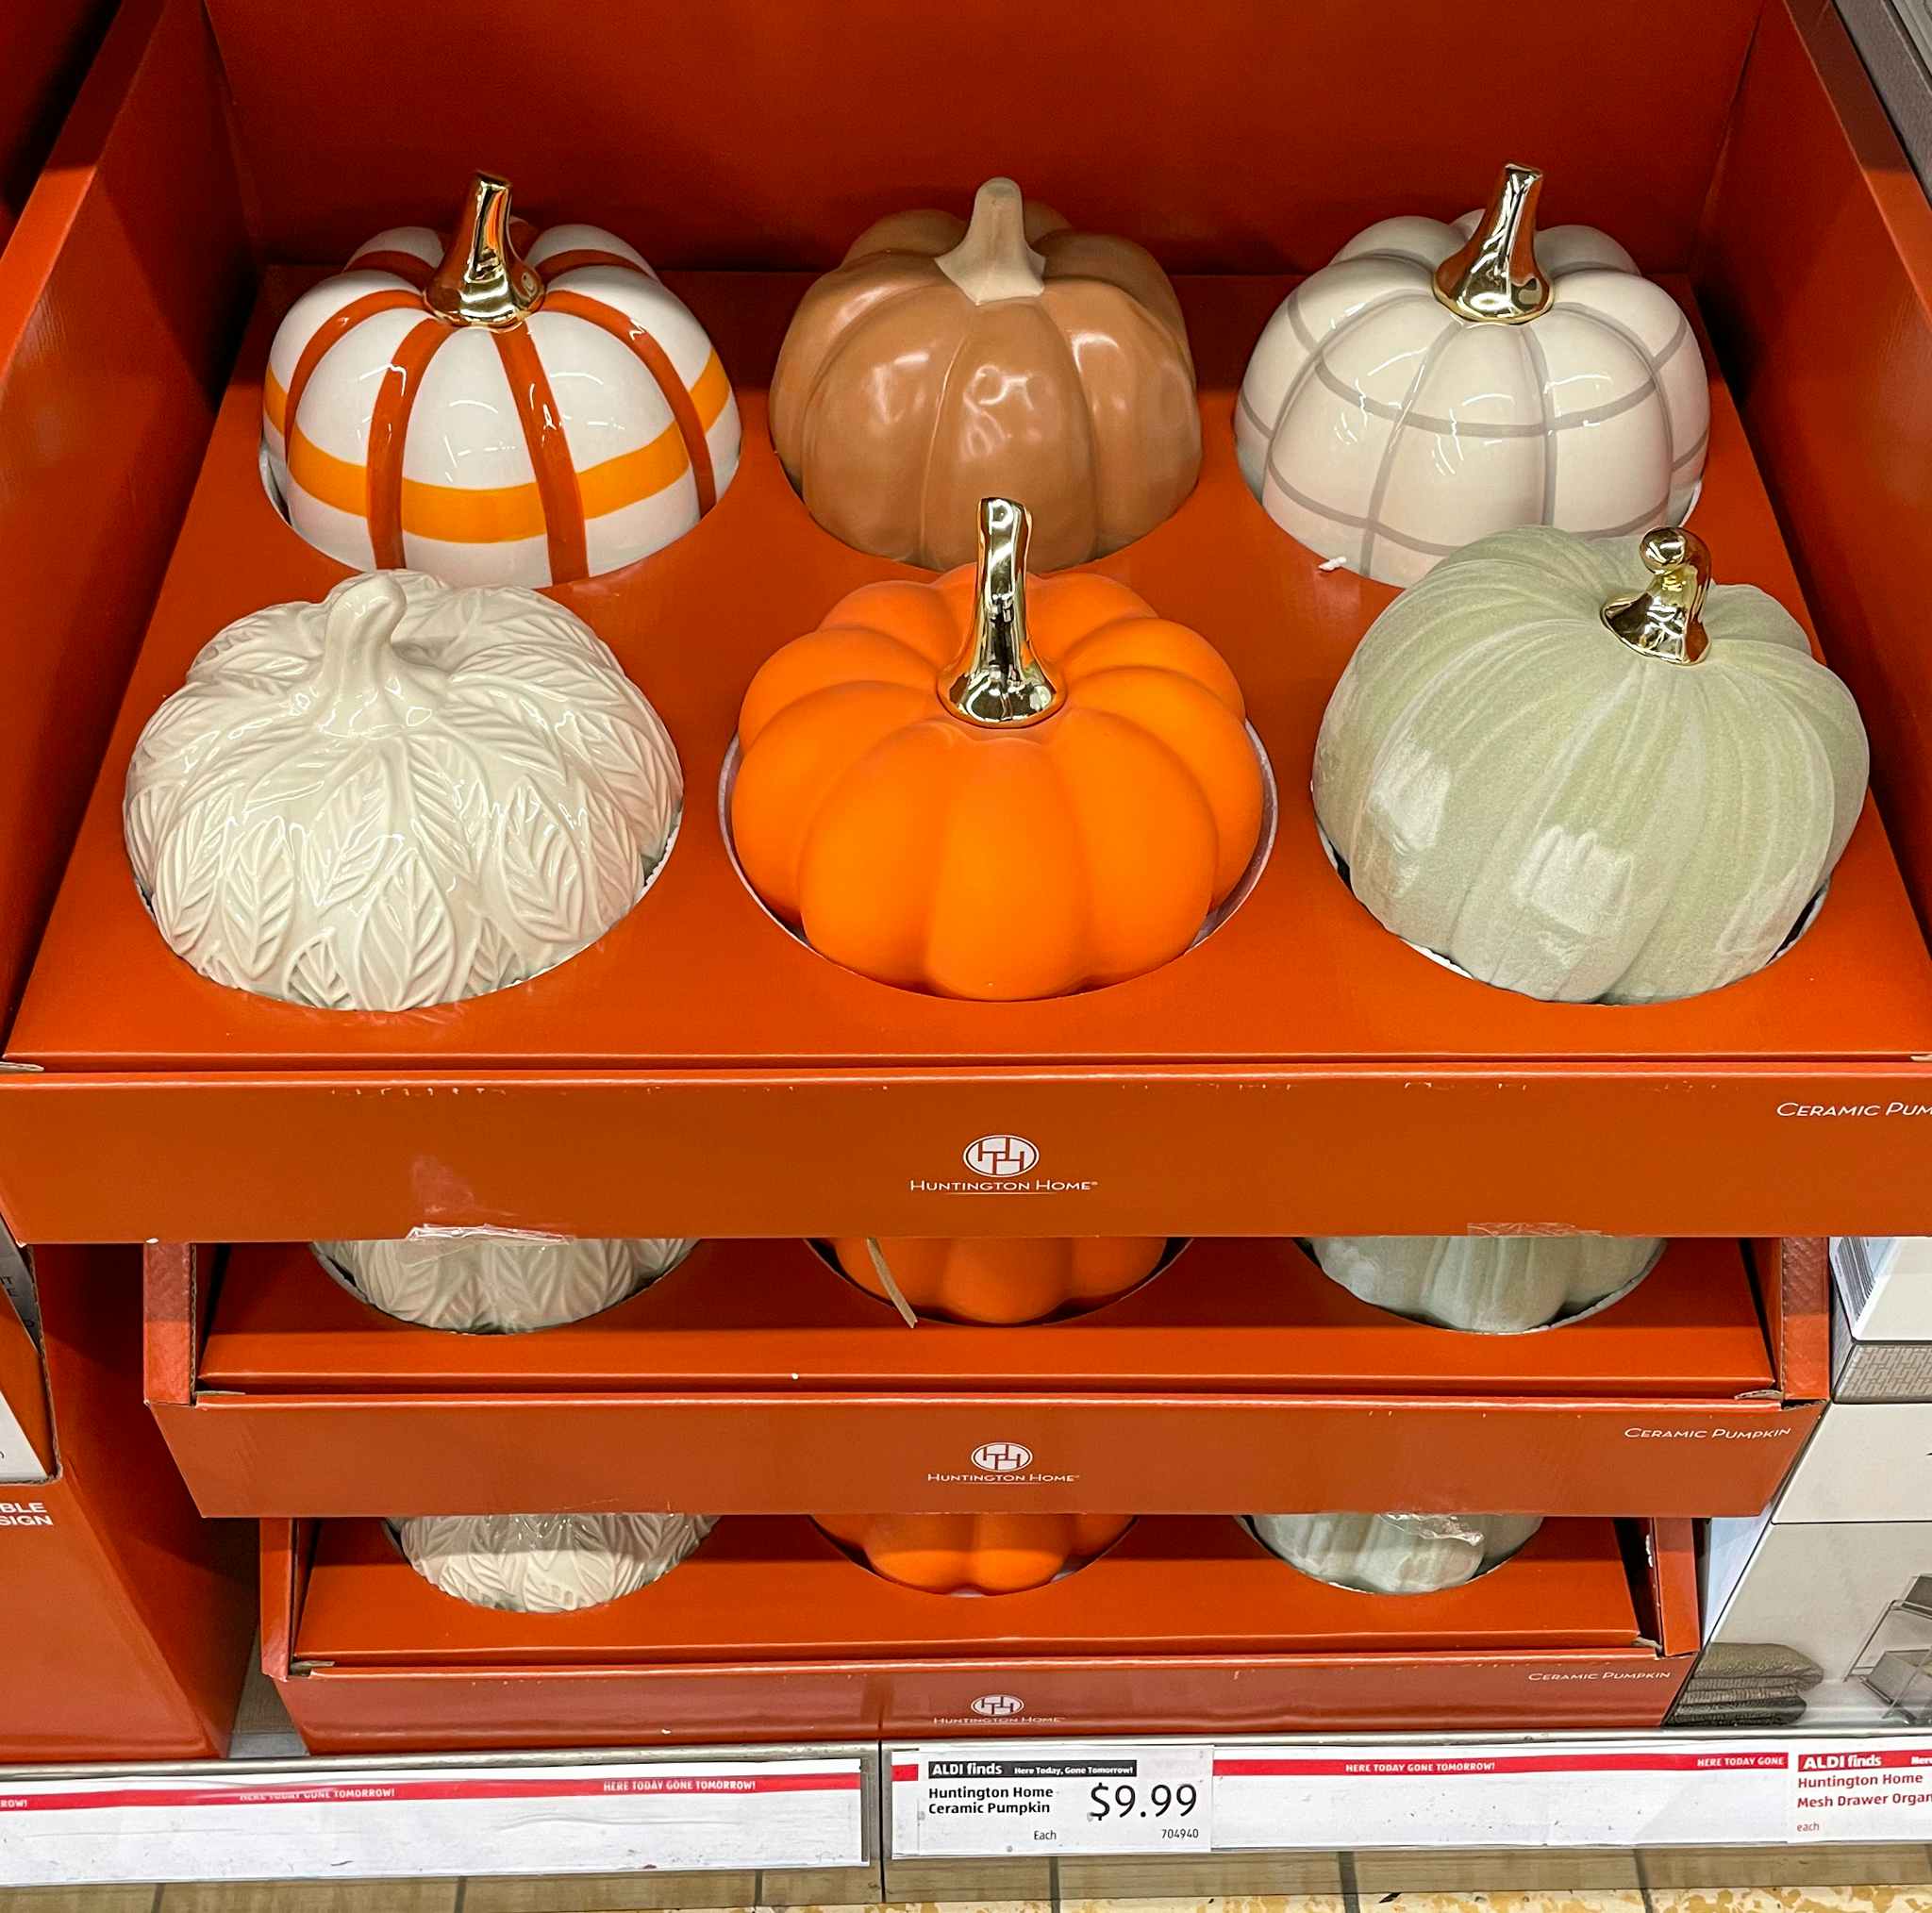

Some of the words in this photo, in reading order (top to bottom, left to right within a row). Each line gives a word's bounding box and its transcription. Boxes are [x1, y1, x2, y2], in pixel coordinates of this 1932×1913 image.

[1776, 1102, 1881, 1117] CERAMIC
[910, 1180, 1030, 1192] HUNTINGTON
[1624, 1427, 1707, 1439] CERAMIC
[1711, 1427, 1791, 1439] PUMPKIN
[927, 1473, 1025, 1483] HUNTINGTON
[1528, 1672, 1598, 1681] CERAMIC
[1602, 1672, 1671, 1680] PUMPKIN
[1345, 1764, 1371, 1772] HERE
[1407, 1763, 1433, 1772] GONE
[1436, 1762, 1494, 1772] TOMORROW!
[1697, 1757, 1722, 1767] HERE
[1724, 1757, 1756, 1766] TODAY
[1757, 1756, 1784, 1765] GONE
[1804, 1755, 1844, 1770] ALDI
[1847, 1755, 1881, 1768] finds
[932, 1763, 963, 1775] ALDI
[967, 1762, 1003, 1775] finds
[1036, 1767, 1063, 1776] Today,
[1087, 1766, 1133, 1774] Tomorrow!
[603, 1781, 629, 1791] HERE
[632, 1781, 663, 1791] TODAY
[666, 1780, 693, 1790] GONE
[695, 1780, 756, 1789] TOMORROW!
[1798, 1775, 1878, 1789] Huntington
[1882, 1773, 1924, 1785] Home
[333, 1788, 395, 1798] TOMORROW!
[928, 1787, 1009, 1801] Huntington
[1013, 1787, 1054, 1799] Home
[1090, 1783, 1197, 1821] $9.99
[1797, 1795, 1833, 1808] Mesh
[1838, 1794, 1889, 1807] Drawer
[928, 1802, 984, 1814] Ceramic
[987, 1801, 1051, 1816] Pumpkin
[1796, 1822, 1820, 1832] each
[1033, 1830, 1057, 1840] Each
[1161, 1828, 1199, 1839] 704940
